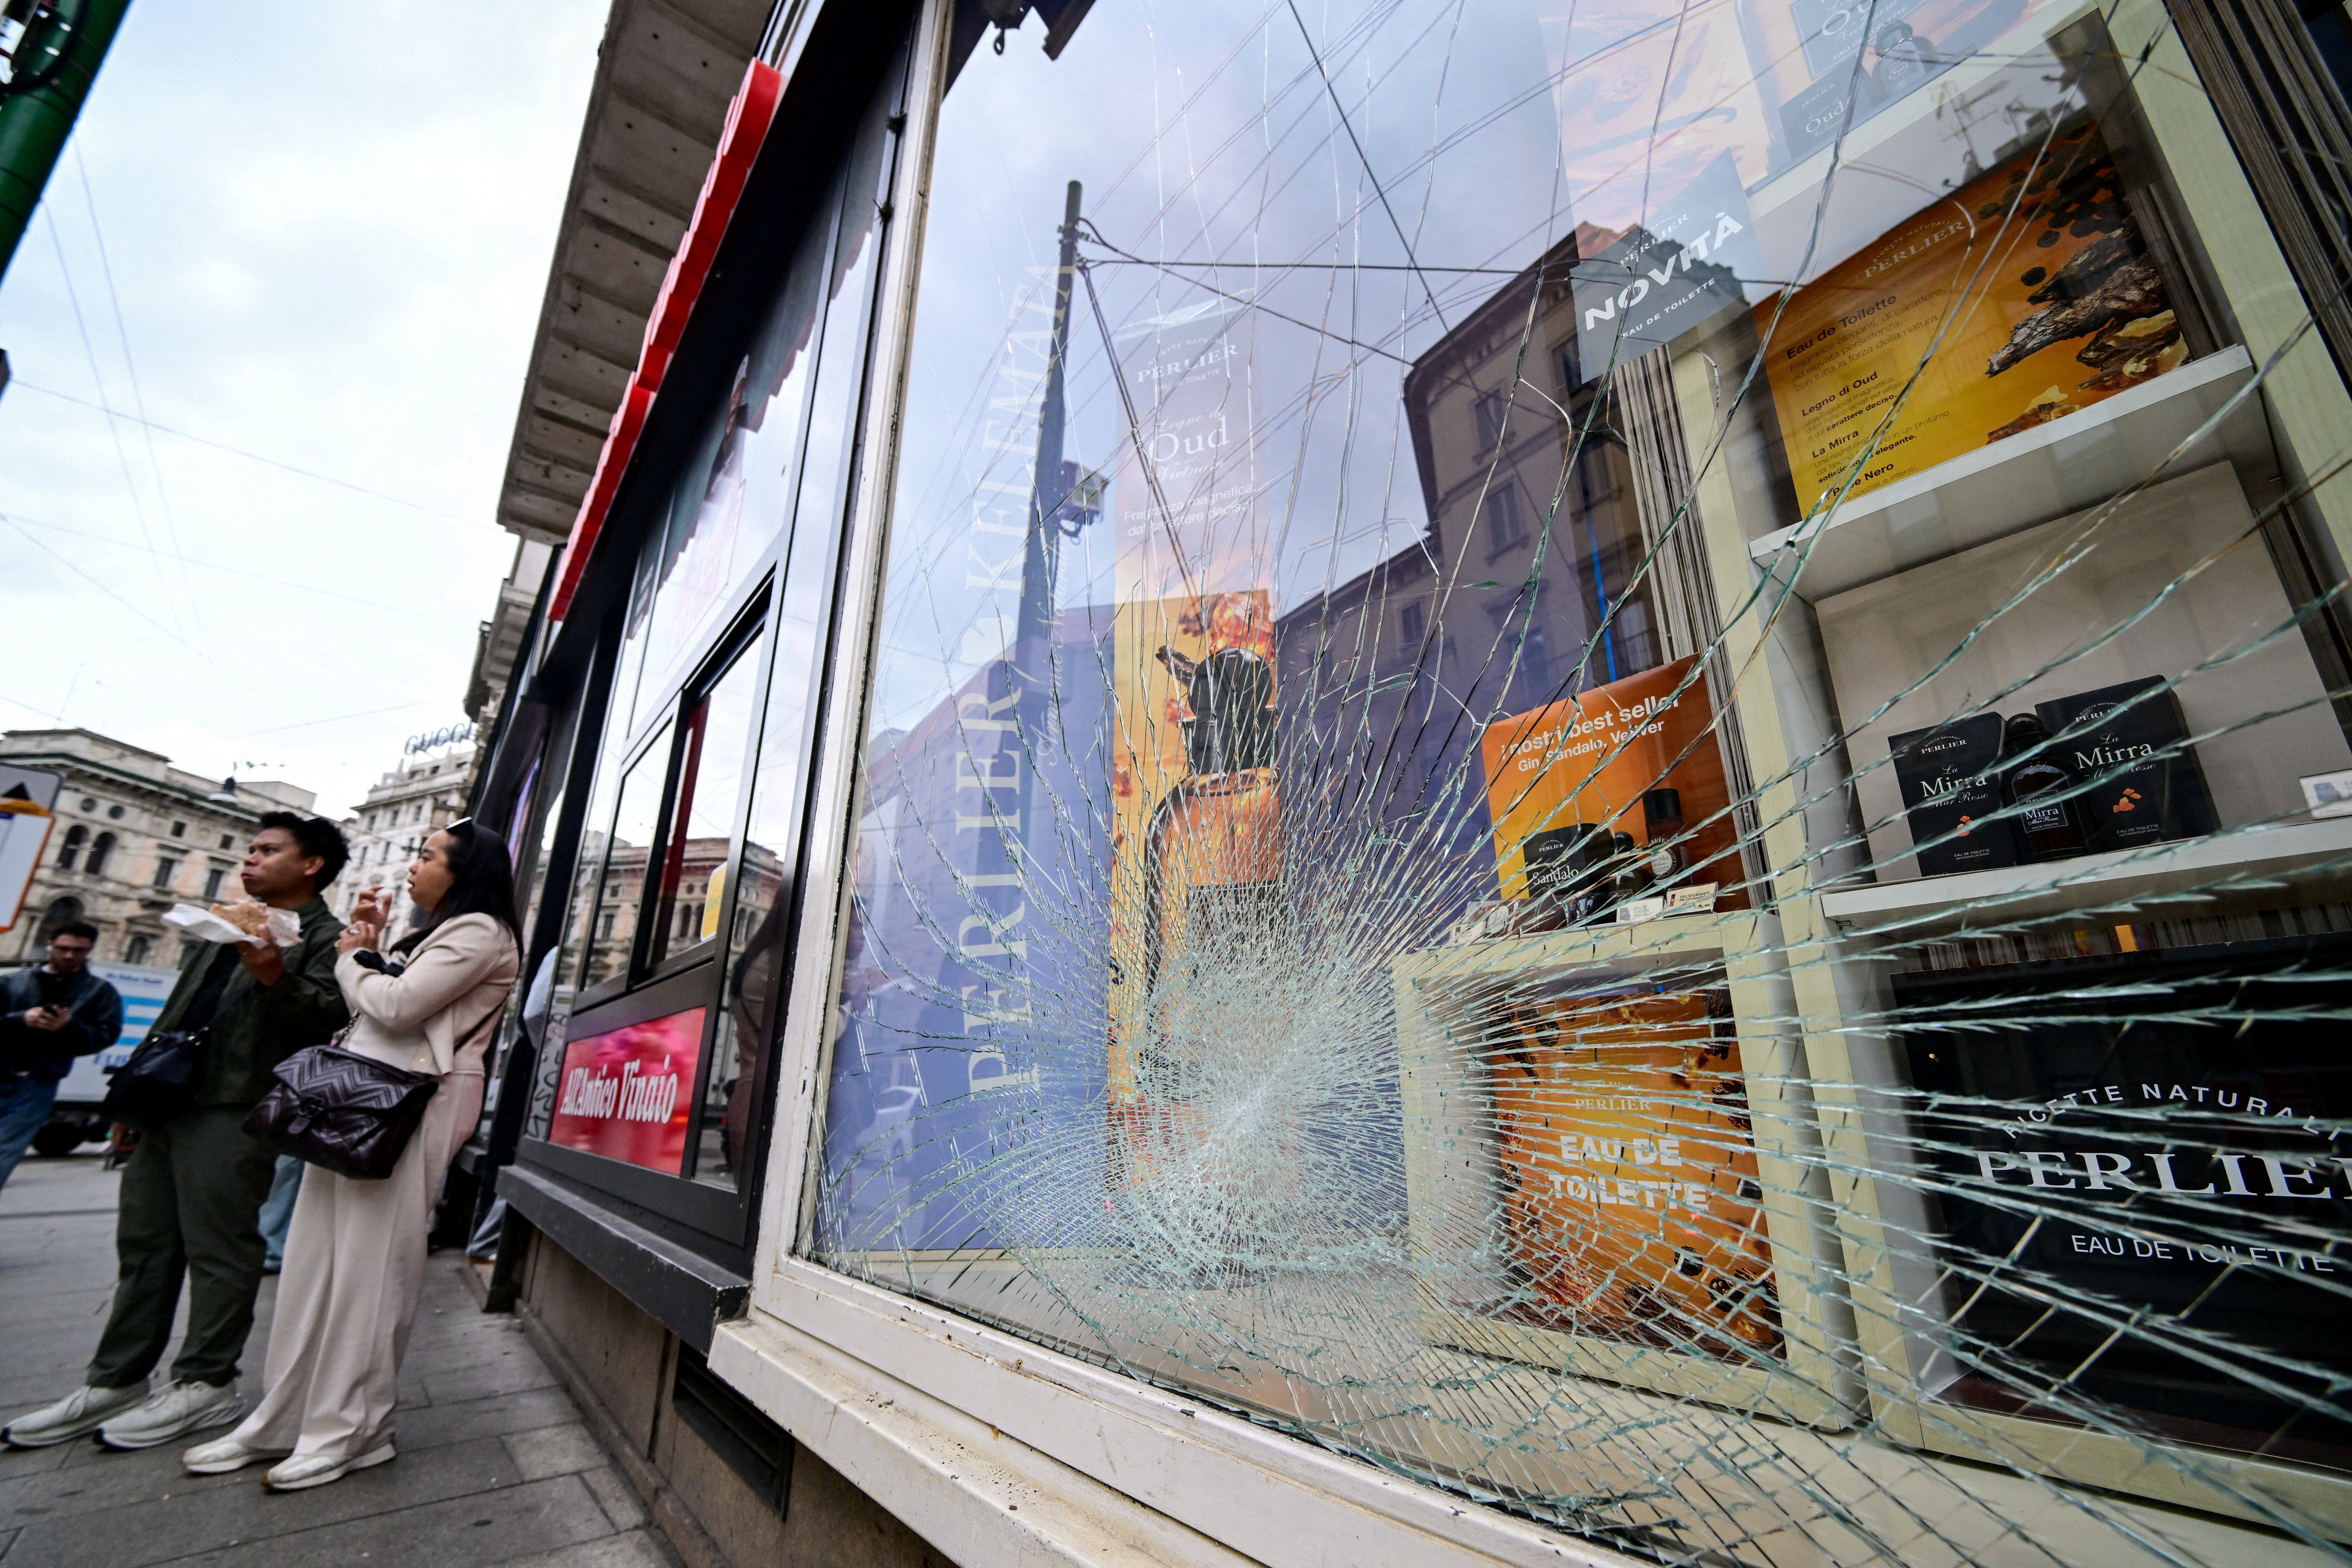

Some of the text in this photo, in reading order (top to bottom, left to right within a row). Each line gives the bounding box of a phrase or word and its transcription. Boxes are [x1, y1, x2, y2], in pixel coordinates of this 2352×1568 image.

[1833, 47, 1850, 60] EAU
[1806, 100, 1845, 132] Oud
[1619, 214, 1689, 267] PERLIER
[1626, 231, 1649, 254] RICETE
[1864, 222, 1966, 279] PERLIER
[1873, 220, 1950, 263] RICETTE NATURALI
[1585, 212, 1743, 331] NOVITÀ
[1622, 278, 1716, 339] EAU DE TOILETTE
[1786, 295, 1897, 359] Eau de Toilette
[1789, 342, 1835, 372] Fragranze
[1882, 312, 1891, 322] di
[1894, 289, 1945, 315] carattere,
[1138, 345, 1238, 383] PERLIER
[1792, 320, 1903, 382] ad elevata persistenza,
[1795, 378, 1813, 392] con
[1815, 365, 1836, 381] tutta
[1837, 358, 1847, 369] la
[1848, 346, 1874, 365] forza
[1876, 333, 1901, 349] della
[1185, 368, 1220, 384] TOILETTE
[1802, 371, 1878, 417] Legno di Oud
[1804, 377, 1895, 426] Una fragranza magnetica,
[1806, 370, 1927, 434] dalle note orientali ed affascinnti
[965, 264, 1077, 597] KELEMATA
[1156, 413, 1204, 433] Legno
[1815, 427, 1825, 438] dal
[1826, 408, 1864, 432] carattere
[1866, 394, 1897, 411] deciso.
[1148, 415, 1230, 462] Oud
[1812, 447, 1826, 459] La
[1828, 430, 1859, 451] Mirra
[1816, 465, 1828, 476] dal
[1828, 452, 1854, 471] fascino
[1902, 426, 1912, 435] un
[1914, 410, 1949, 430] profumo
[1814, 457, 1829, 468] Una
[1830, 446, 1851, 460] resina
[1818, 459, 1860, 483] sofisticto
[1875, 435, 1916, 456] elegante.
[1864, 463, 1894, 481] Nero
[1853, 480, 1880, 499] speziati
[1890, 465, 1918, 481] intensi,
[1124, 501, 1184, 522] Fragranza
[1152, 513, 1204, 532] carattere
[2080, 704, 2096, 715] RICETTE
[404, 722, 472, 755] GUCCI
[1501, 695, 1682, 760] i nostri best seller
[1925, 738, 1940, 747] RICETTE
[2100, 732, 2118, 744] La
[1546, 739, 1608, 763] Sandalo,
[1922, 740, 1967, 754] PERLIER
[2074, 744, 2154, 769] Mirra
[1942, 764, 1958, 775] La
[2121, 763, 2155, 775] osso
[1920, 776, 1987, 797] Mirra
[1958, 791, 1988, 803] Rosso
[2025, 808, 2059, 819] Mirra
[1539, 843, 1563, 852] PERLIER
[1533, 865, 1579, 885] Sandalo
[956, 686, 1040, 1102] PERLIER
[1574, 1098, 1653, 1111] PERLIER
[2003, 1083, 2342, 1140] RICETTE NATURALI
[1560, 1135, 1682, 1166] EAU DE
[1547, 1175, 1710, 1211] TOILETTE
[2072, 1235, 2335, 1272] EAU DE TOILETTE
